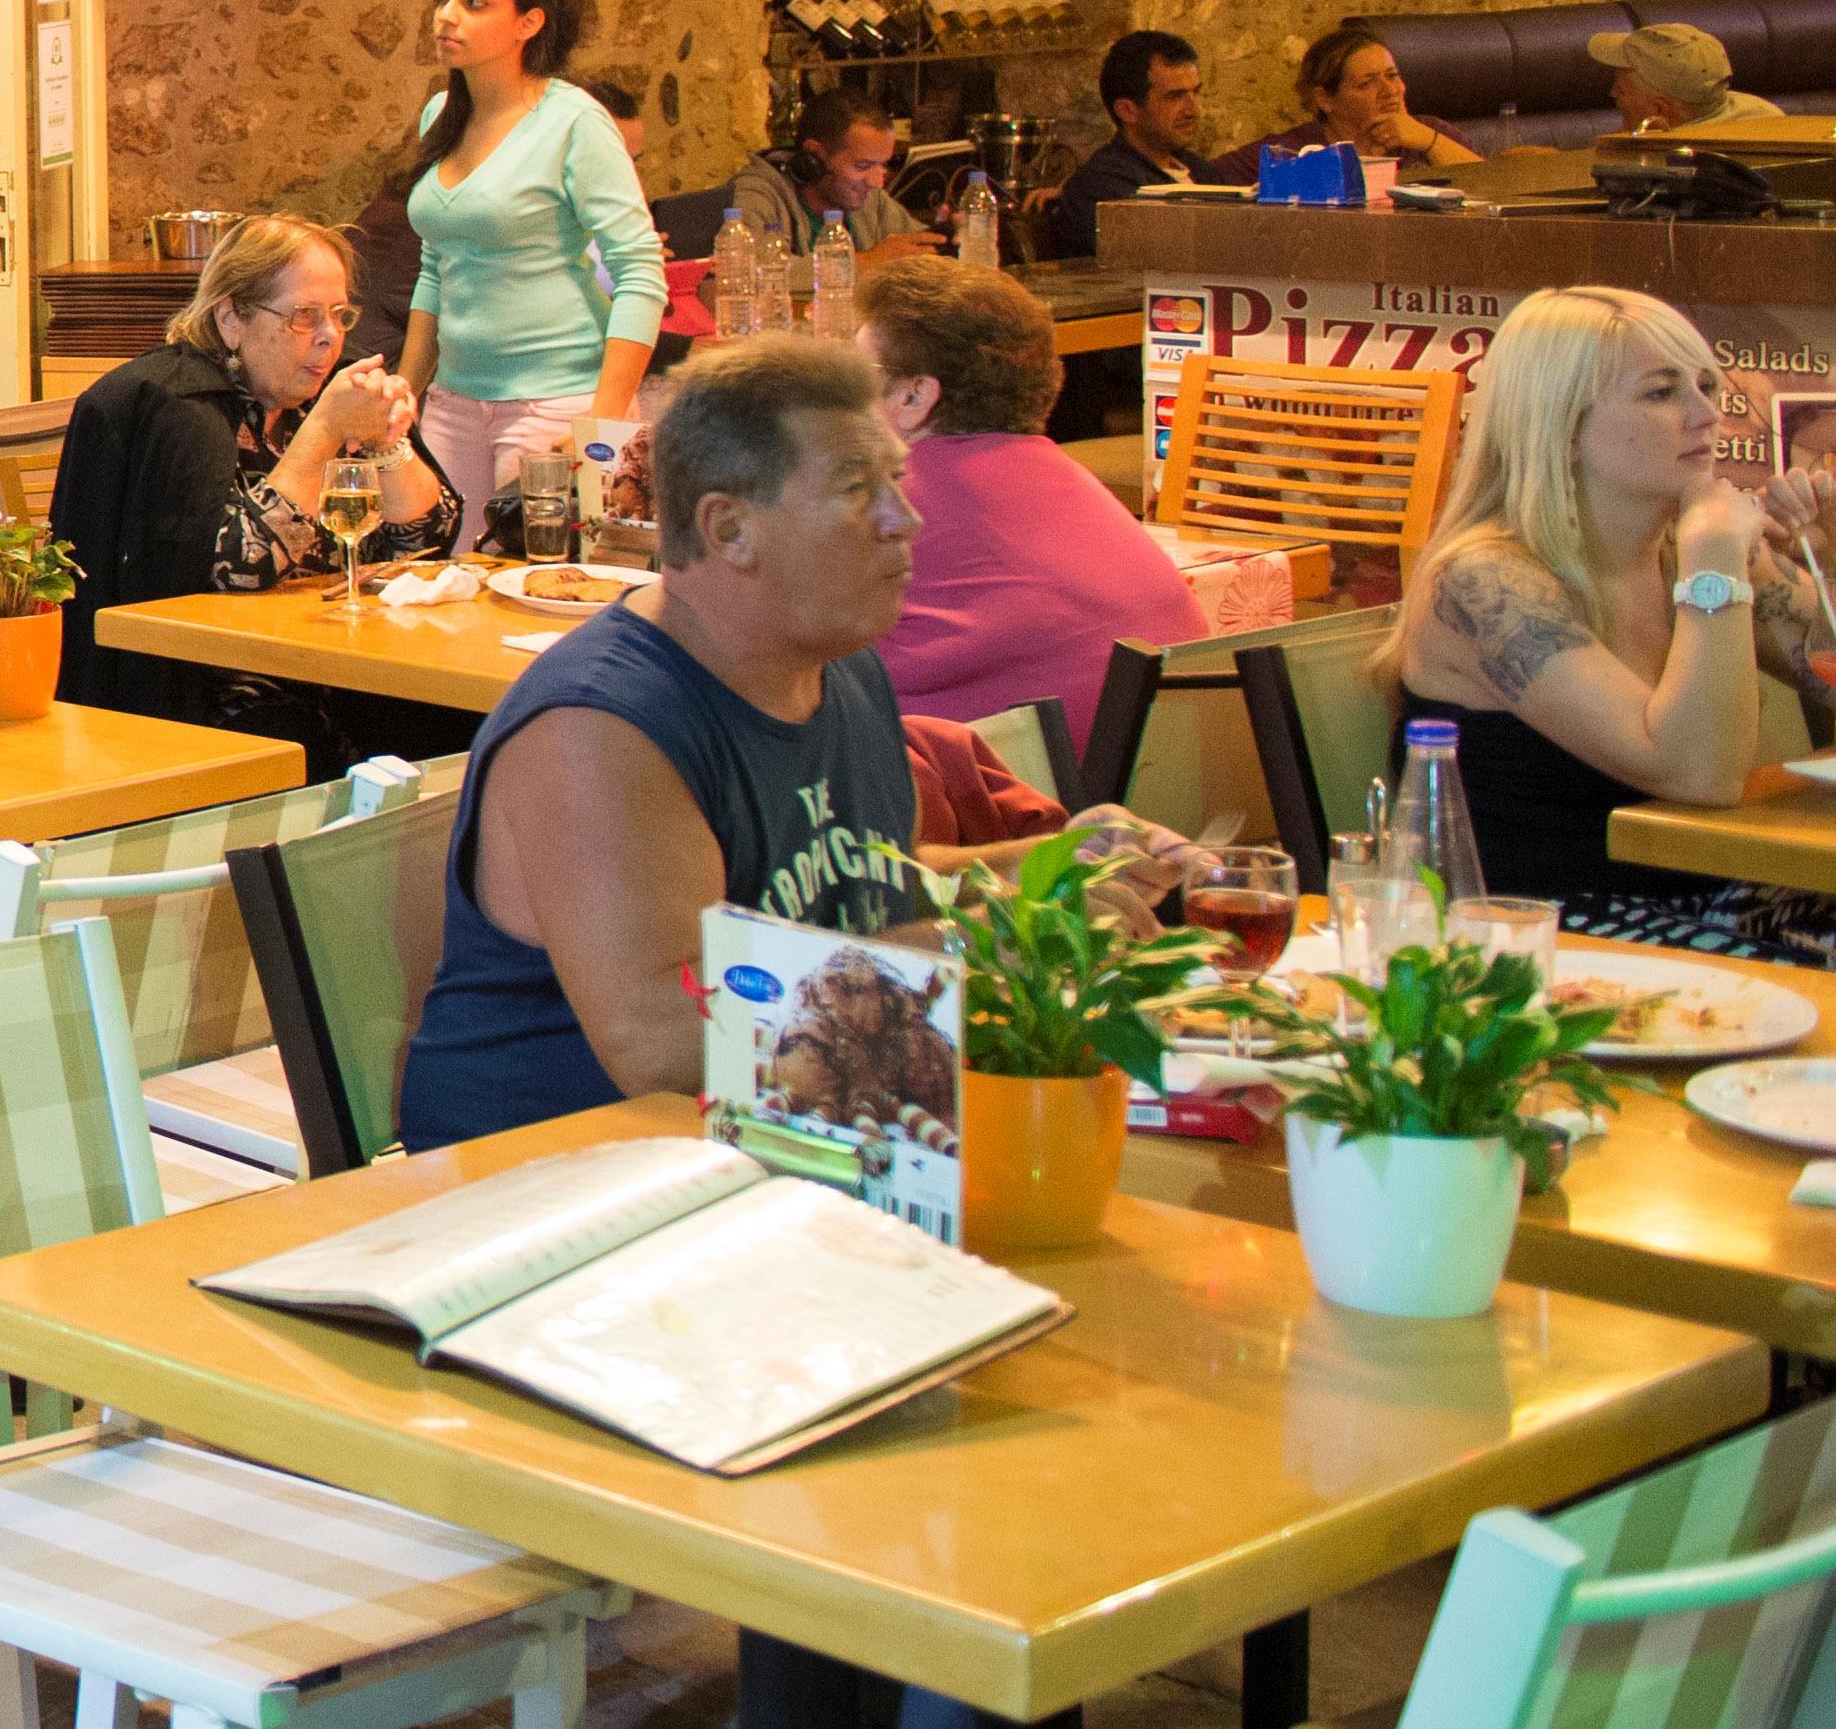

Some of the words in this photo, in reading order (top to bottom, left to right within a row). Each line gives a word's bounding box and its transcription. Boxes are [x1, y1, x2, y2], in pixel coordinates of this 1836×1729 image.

[1370, 280, 1502, 318] Italian
[1158, 346, 1194, 362] VIS
[1714, 339, 1829, 375] Salads
